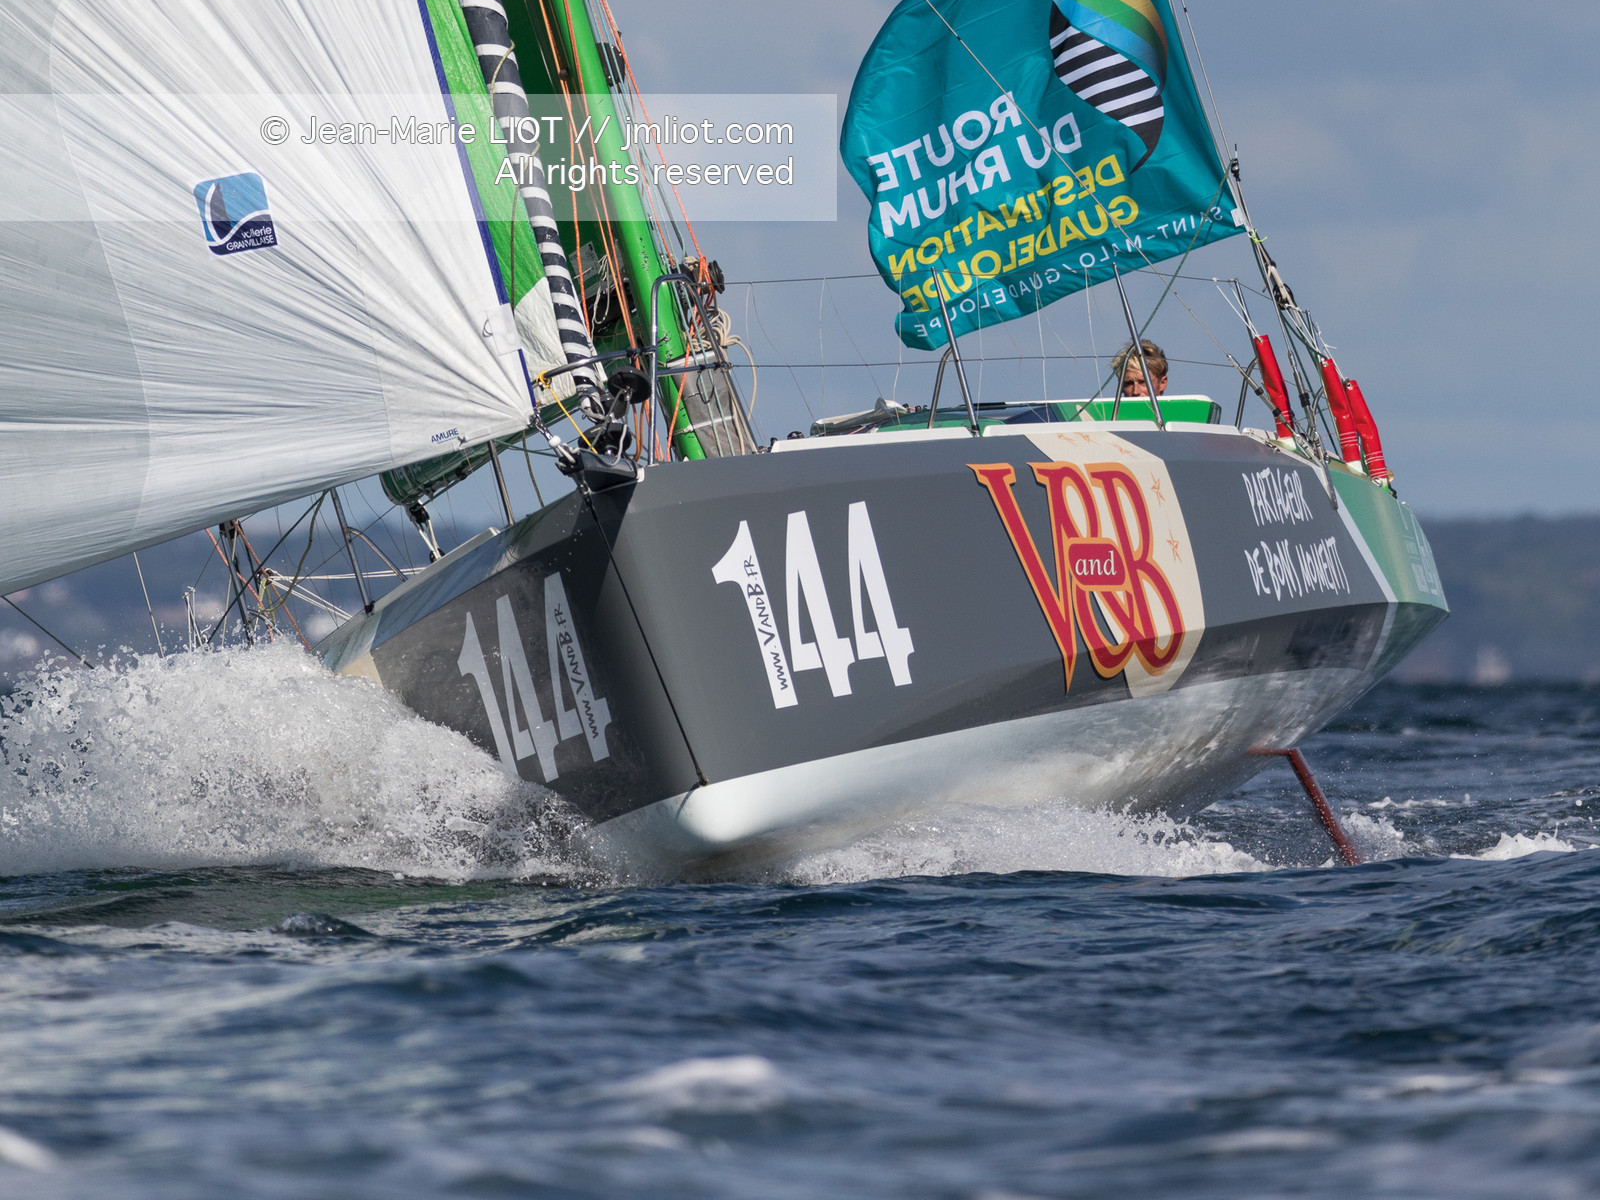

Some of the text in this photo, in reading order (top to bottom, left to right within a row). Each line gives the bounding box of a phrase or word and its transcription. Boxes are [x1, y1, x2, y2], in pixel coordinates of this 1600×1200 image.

[430, 427, 459, 443] AMURE
[1241, 467, 1314, 527] PARTAGEUR
[1075, 550, 1117, 576] and
[1244, 547, 1271, 596] DE
[711, 500, 915, 709] 144
[457, 572, 612, 783] 144
